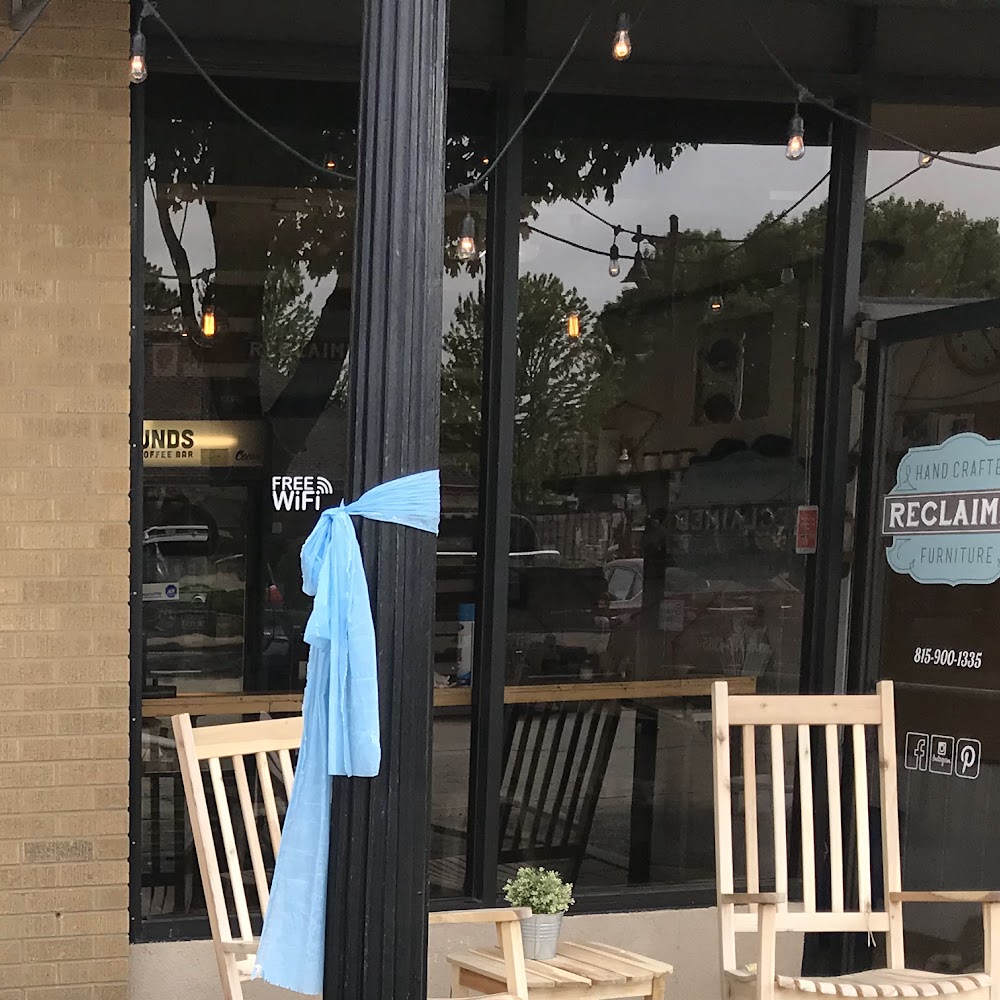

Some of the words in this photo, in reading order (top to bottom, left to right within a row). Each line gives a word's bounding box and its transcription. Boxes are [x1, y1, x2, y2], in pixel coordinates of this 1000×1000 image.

[176, 450, 193, 459] BAR
[915, 462, 949, 481] HAND
[271, 476, 314, 490] FREE
[272, 490, 321, 511] WiFi
[889, 497, 1000, 529] RECLAIM
[920, 546, 994, 564] FURNITURE
[914, 647, 982, 669] 815-900-1335
